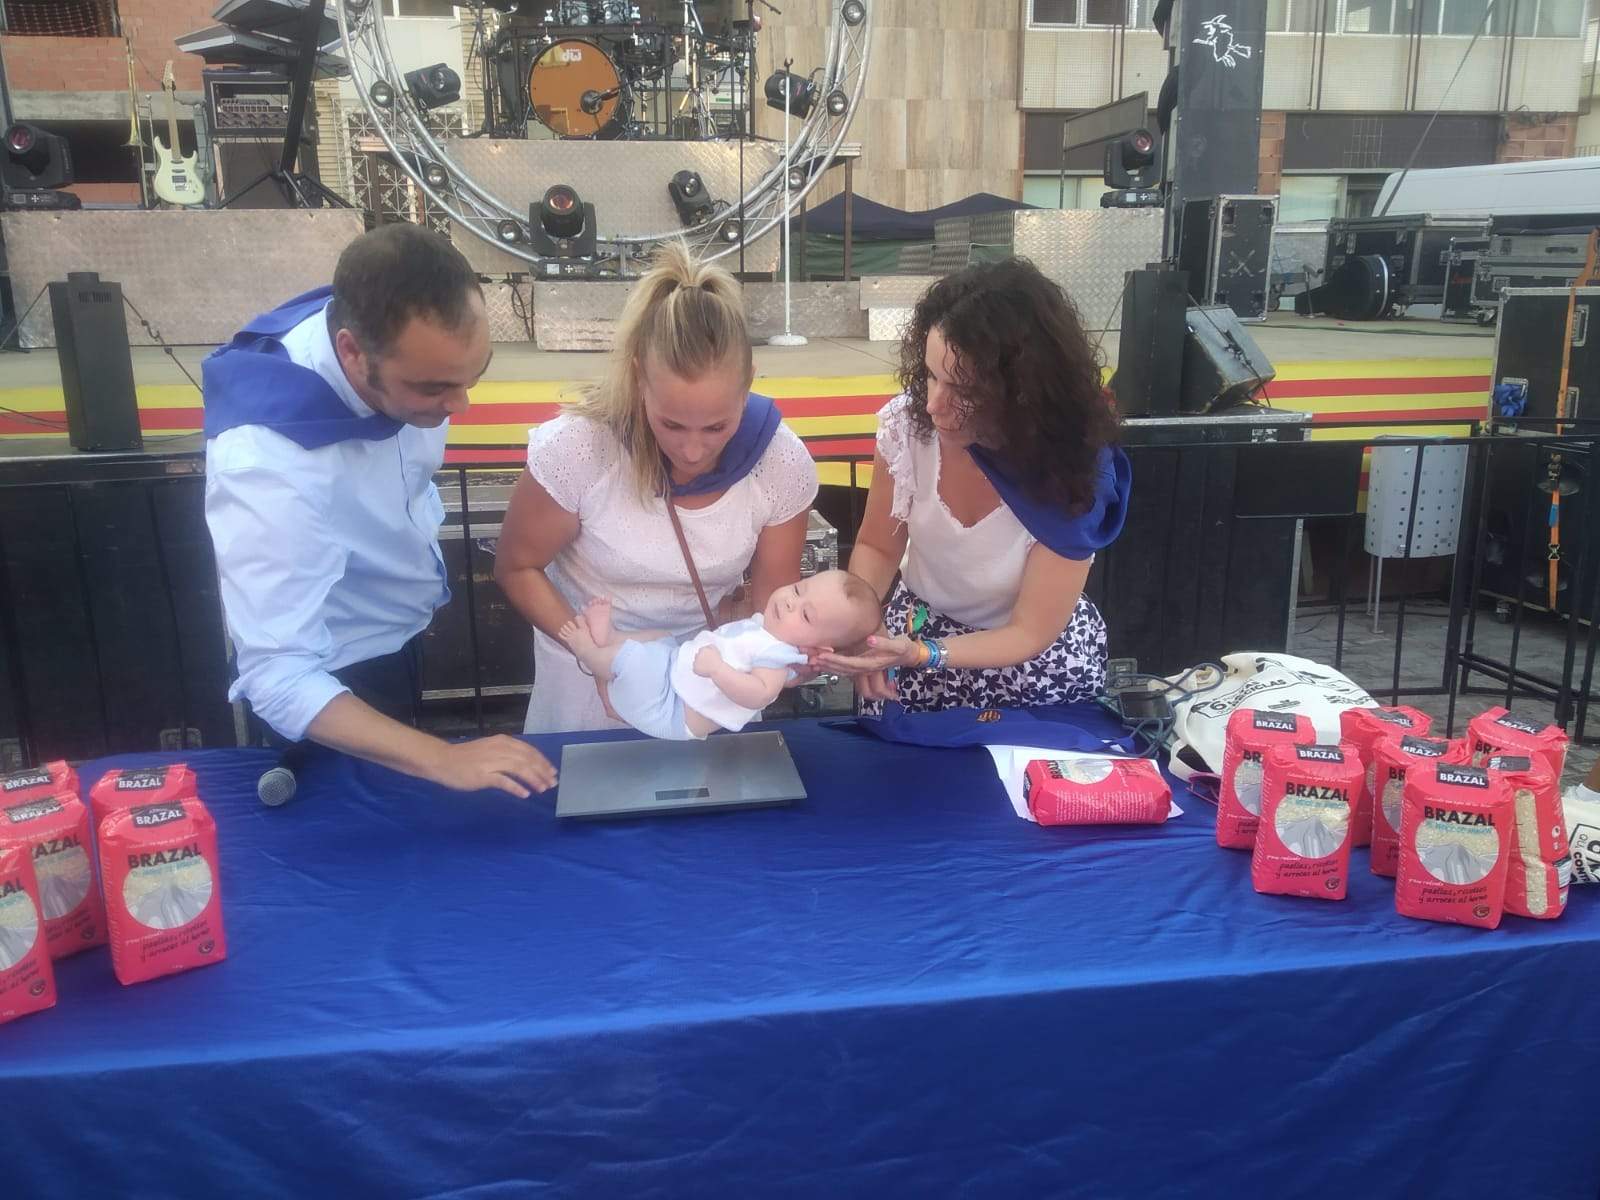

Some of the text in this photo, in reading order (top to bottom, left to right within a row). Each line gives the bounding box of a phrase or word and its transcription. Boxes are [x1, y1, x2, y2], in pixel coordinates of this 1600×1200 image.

[1255, 720, 1295, 731] BRAZAL
[1475, 740, 1502, 755] BR
[1242, 749, 1264, 764] BR
[1299, 750, 1342, 761] BRAZAL
[4, 775, 51, 790] BRAZAL
[118, 777, 162, 789] BRAZAL
[1439, 772, 1486, 786] BRAZAL
[1286, 781, 1350, 802] BRAZAL
[135, 809, 182, 825] BRAZAL
[1424, 805, 1496, 827] BRAZAL
[127, 842, 202, 869] BRAZAL
